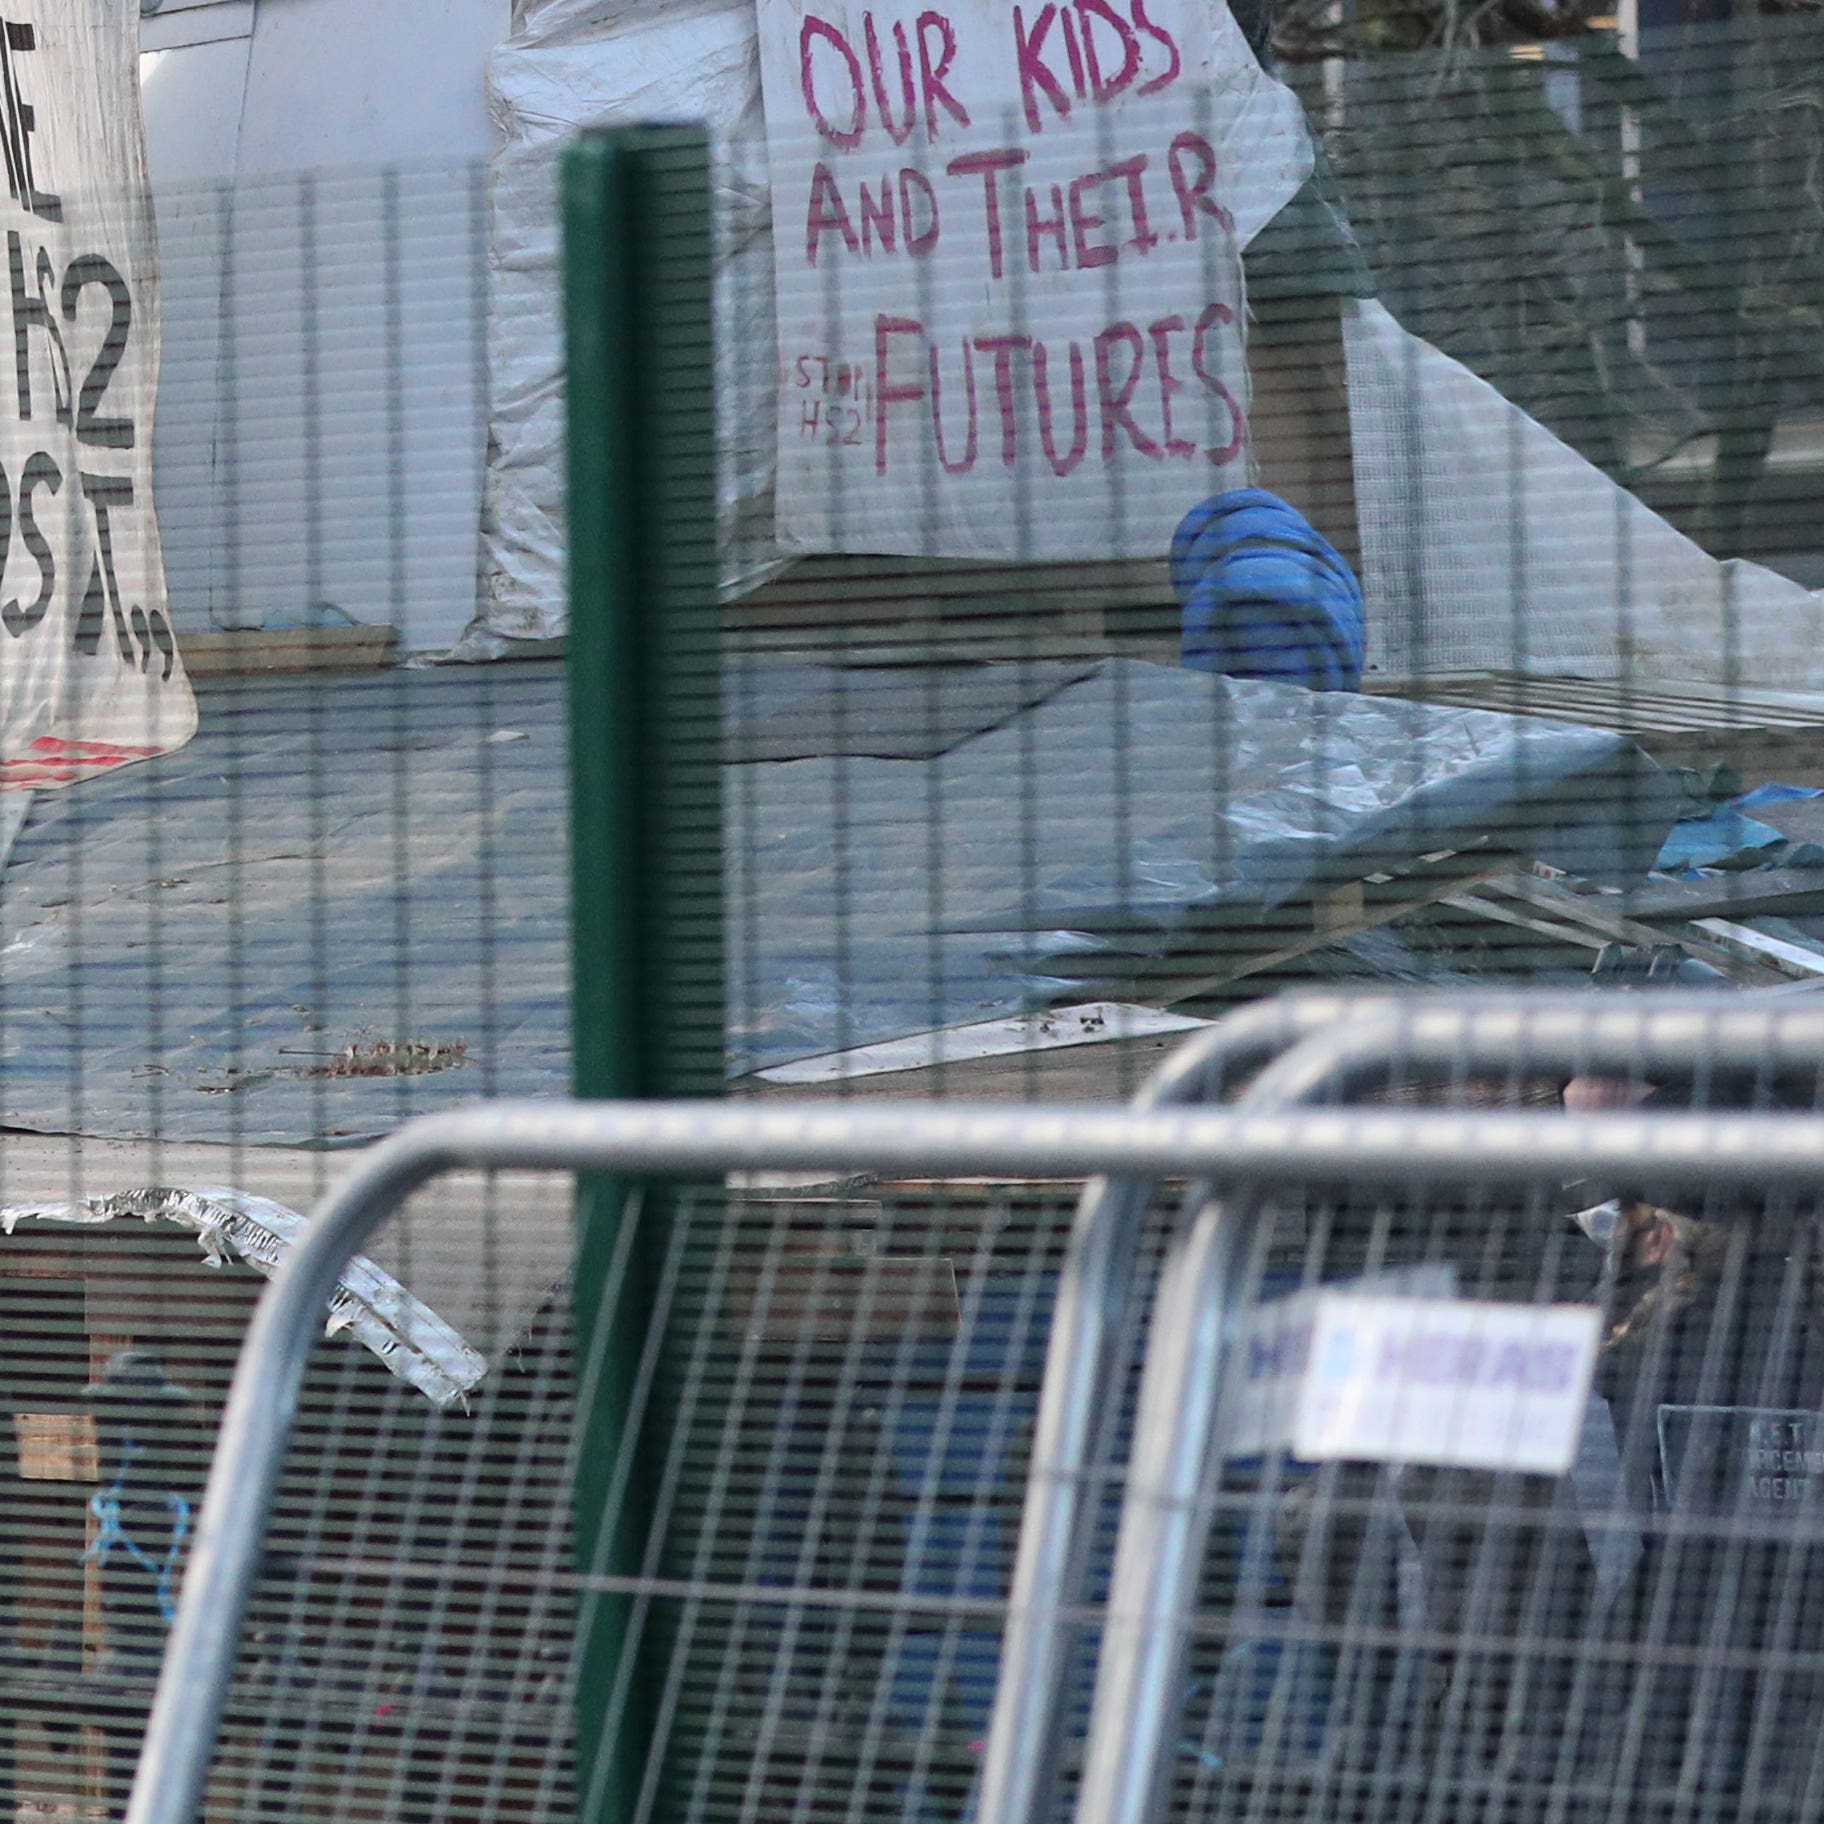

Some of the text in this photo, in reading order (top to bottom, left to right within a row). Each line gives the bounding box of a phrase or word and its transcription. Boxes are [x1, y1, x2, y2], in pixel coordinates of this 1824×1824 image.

[800, 9, 971, 152] OUR
[805, 131, 1236, 280] AND THEIR
[796, 354, 864, 402] STOP
[799, 399, 863, 448] HS2
[874, 302, 1243, 477] FUTURES
